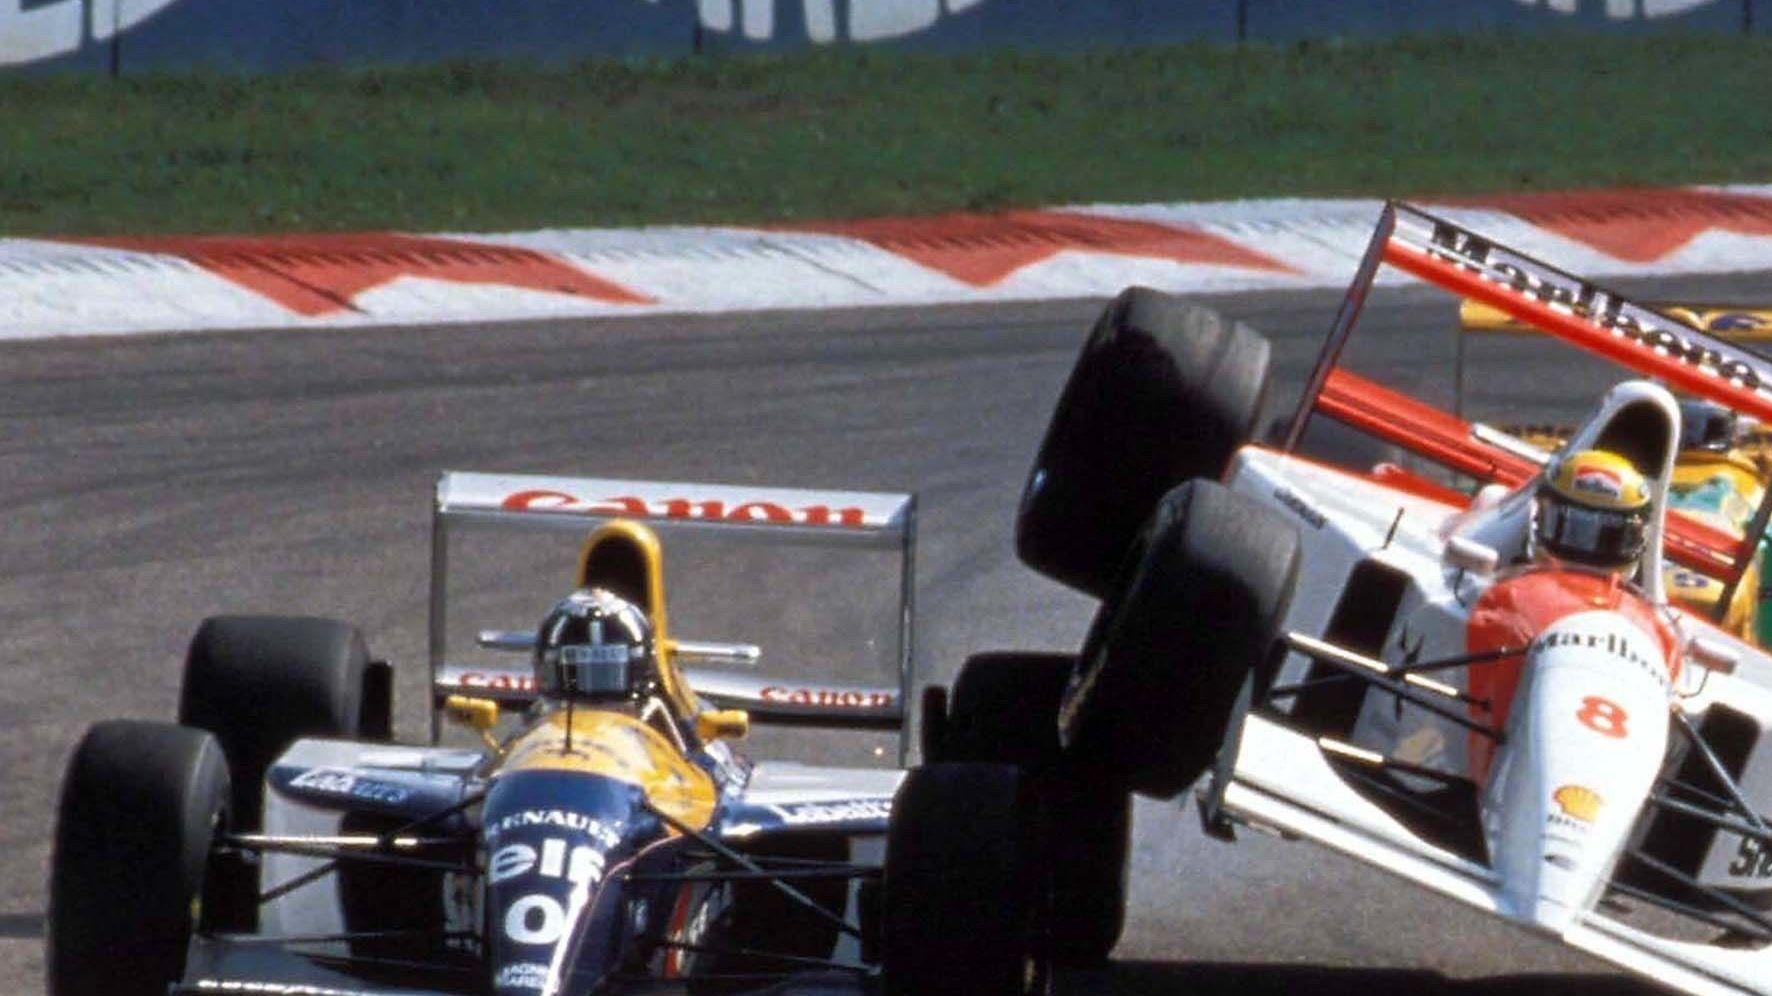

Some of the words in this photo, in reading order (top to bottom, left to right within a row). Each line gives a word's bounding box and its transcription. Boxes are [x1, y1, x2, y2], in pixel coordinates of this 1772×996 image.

[1426, 218, 1762, 392] Marlboro
[501, 489, 866, 527] Canon
[460, 671, 542, 692] Can
[759, 684, 890, 708] Canon
[1576, 695, 1628, 739] 8
[489, 838, 606, 884] elf
